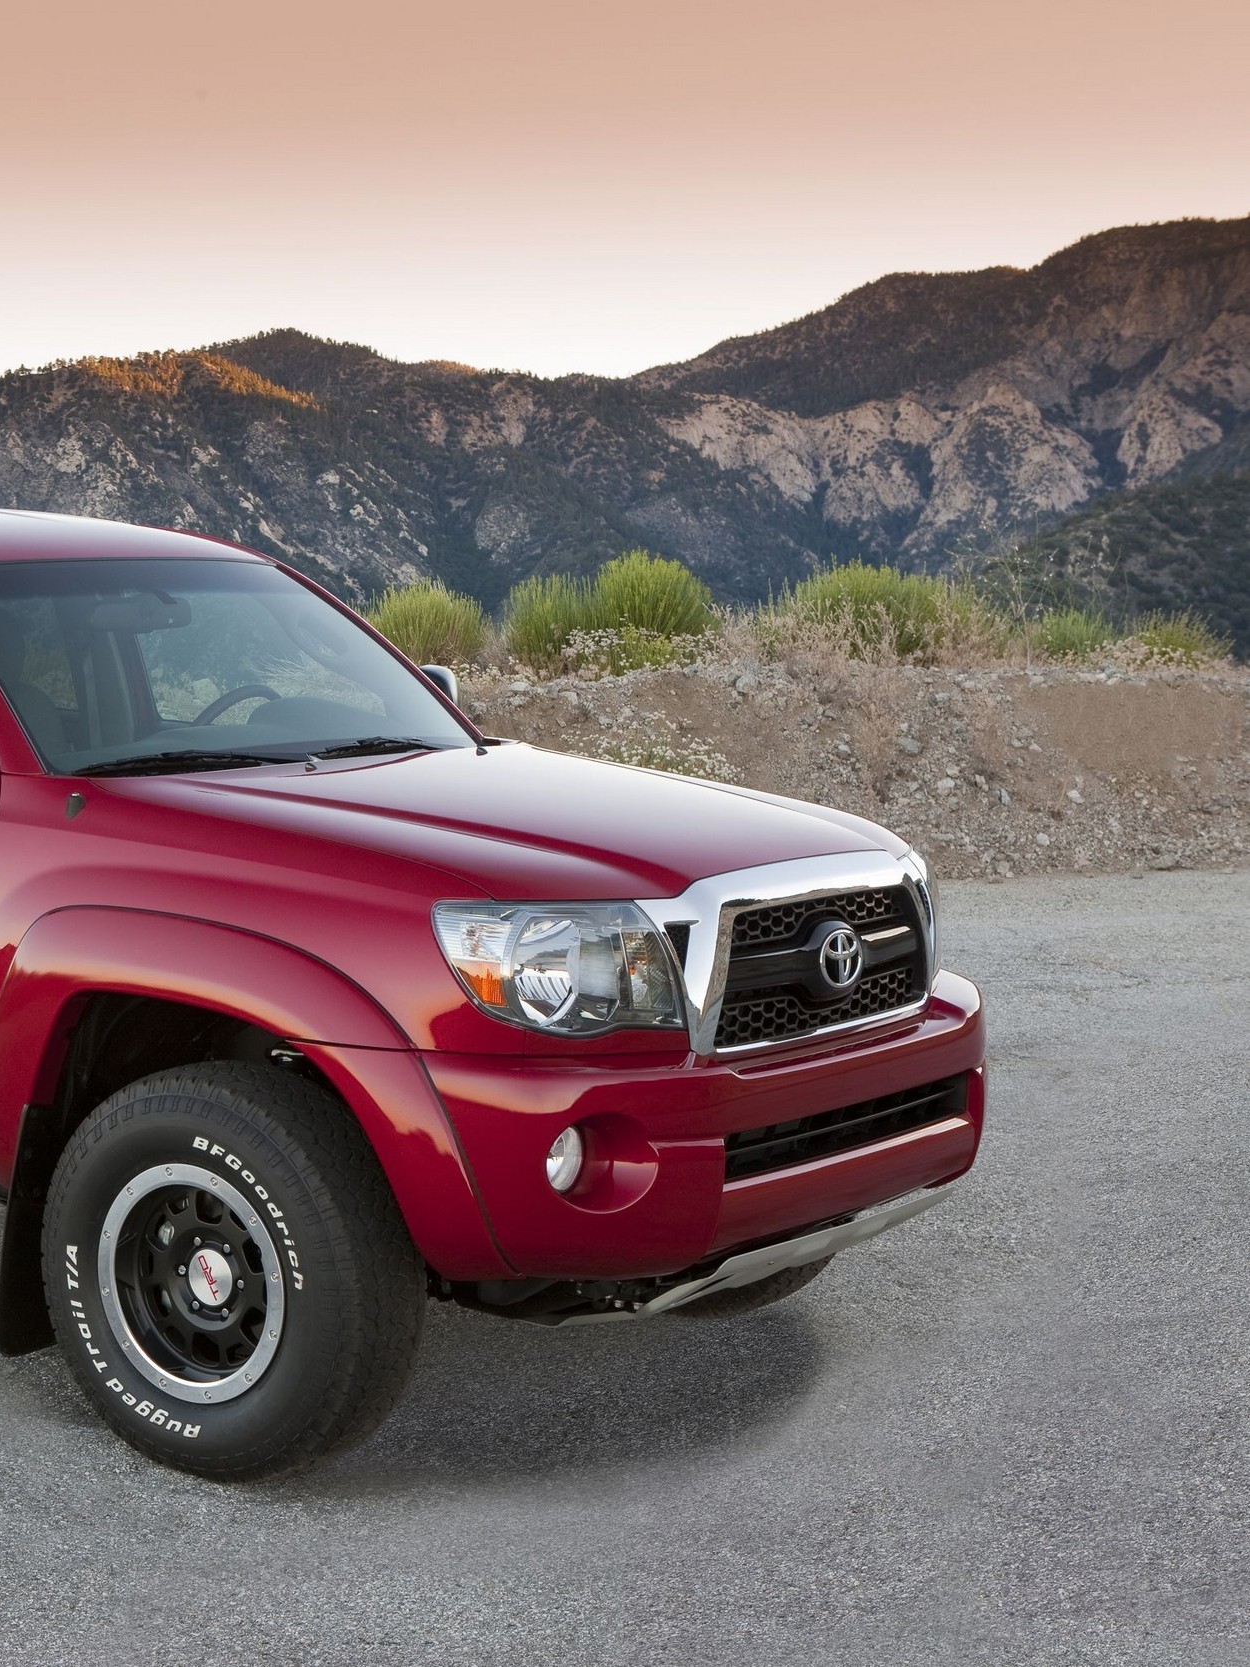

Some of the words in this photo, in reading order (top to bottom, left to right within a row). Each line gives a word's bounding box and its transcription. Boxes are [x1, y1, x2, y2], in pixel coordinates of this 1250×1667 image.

[192, 1136, 303, 1290] BFGoodrich
[65, 1244, 80, 1290] T/A
[198, 1255, 219, 1301] TRD
[70, 1299, 108, 1374] Trail
[106, 1376, 202, 1439] Rugged
